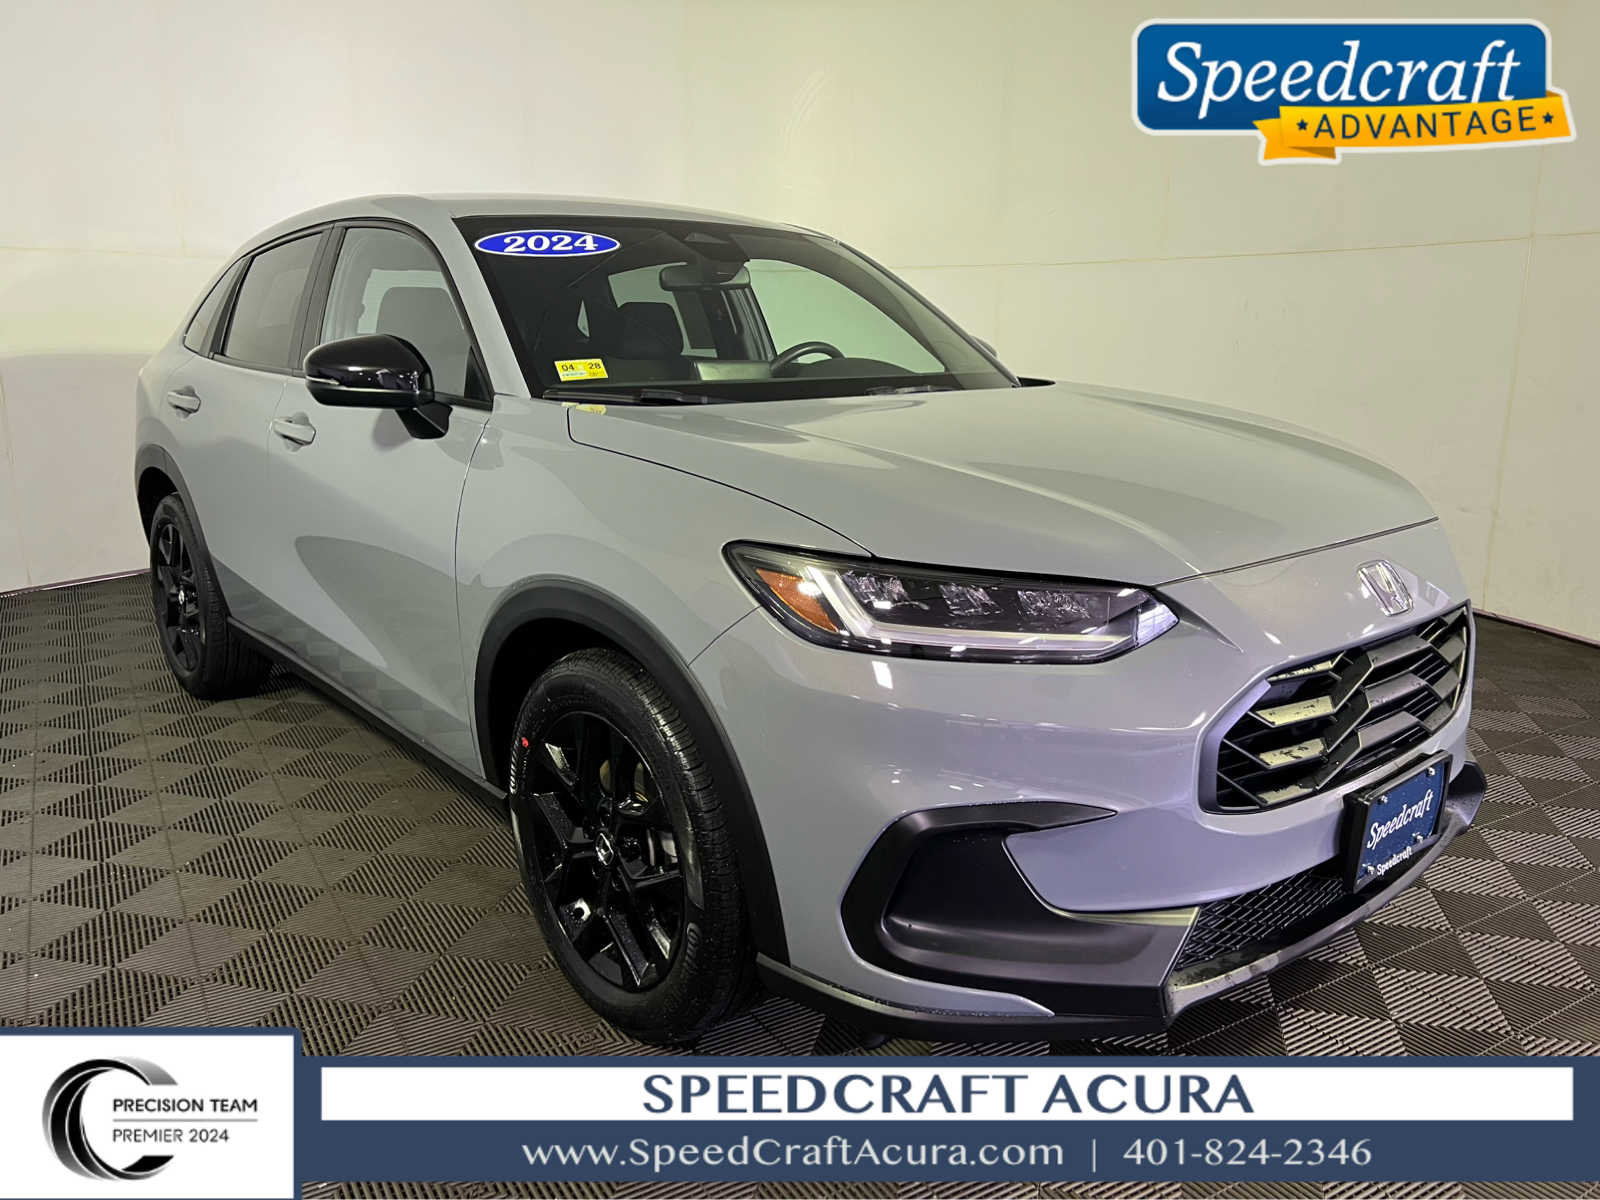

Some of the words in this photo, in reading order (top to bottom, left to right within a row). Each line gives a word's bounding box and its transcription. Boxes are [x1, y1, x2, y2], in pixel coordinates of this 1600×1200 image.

[503, 235, 598, 252] 2024
[1366, 788, 1434, 851] Speedcraft
[1376, 845, 1413, 876] Speedcraft
